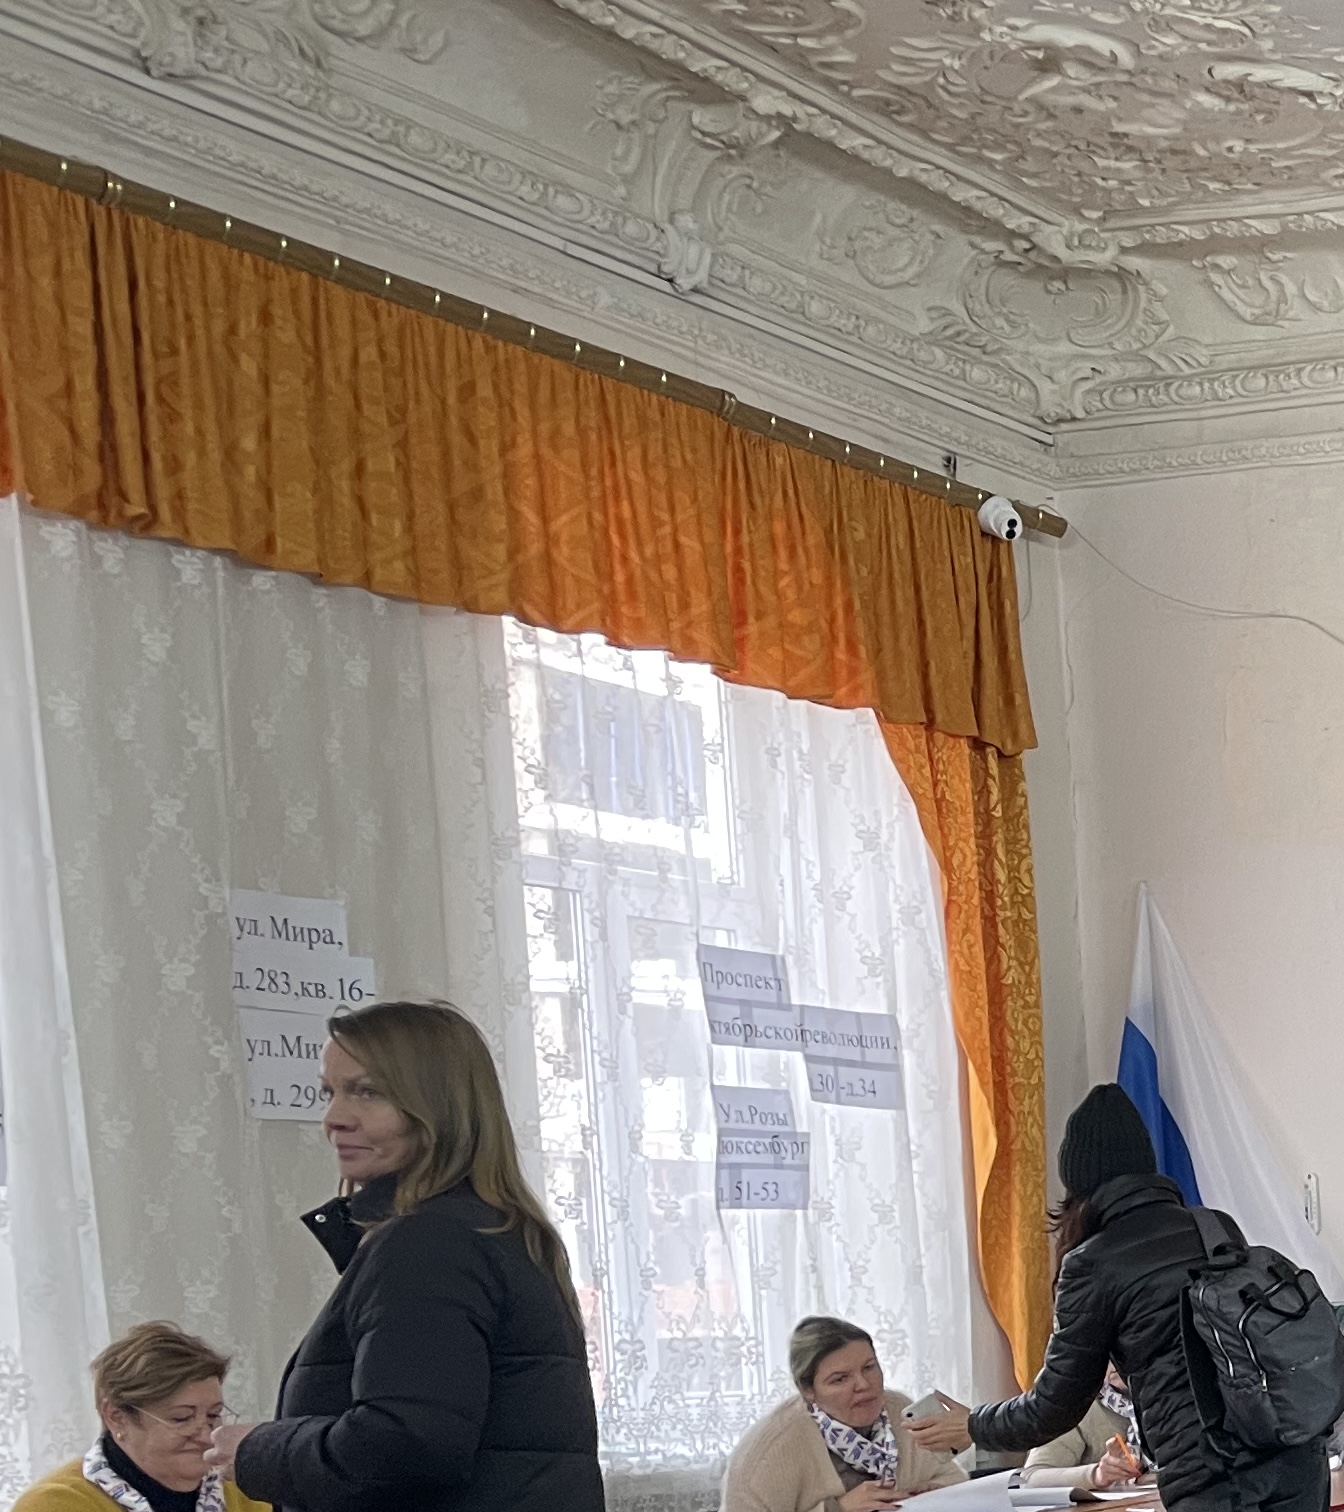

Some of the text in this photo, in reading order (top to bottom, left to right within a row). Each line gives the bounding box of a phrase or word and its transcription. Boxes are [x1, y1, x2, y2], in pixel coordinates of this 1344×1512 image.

[235, 915, 344, 950] ул. Мира,
[702, 961, 785, 992] Проспект
[246, 1034, 323, 1062] ул.Ми
